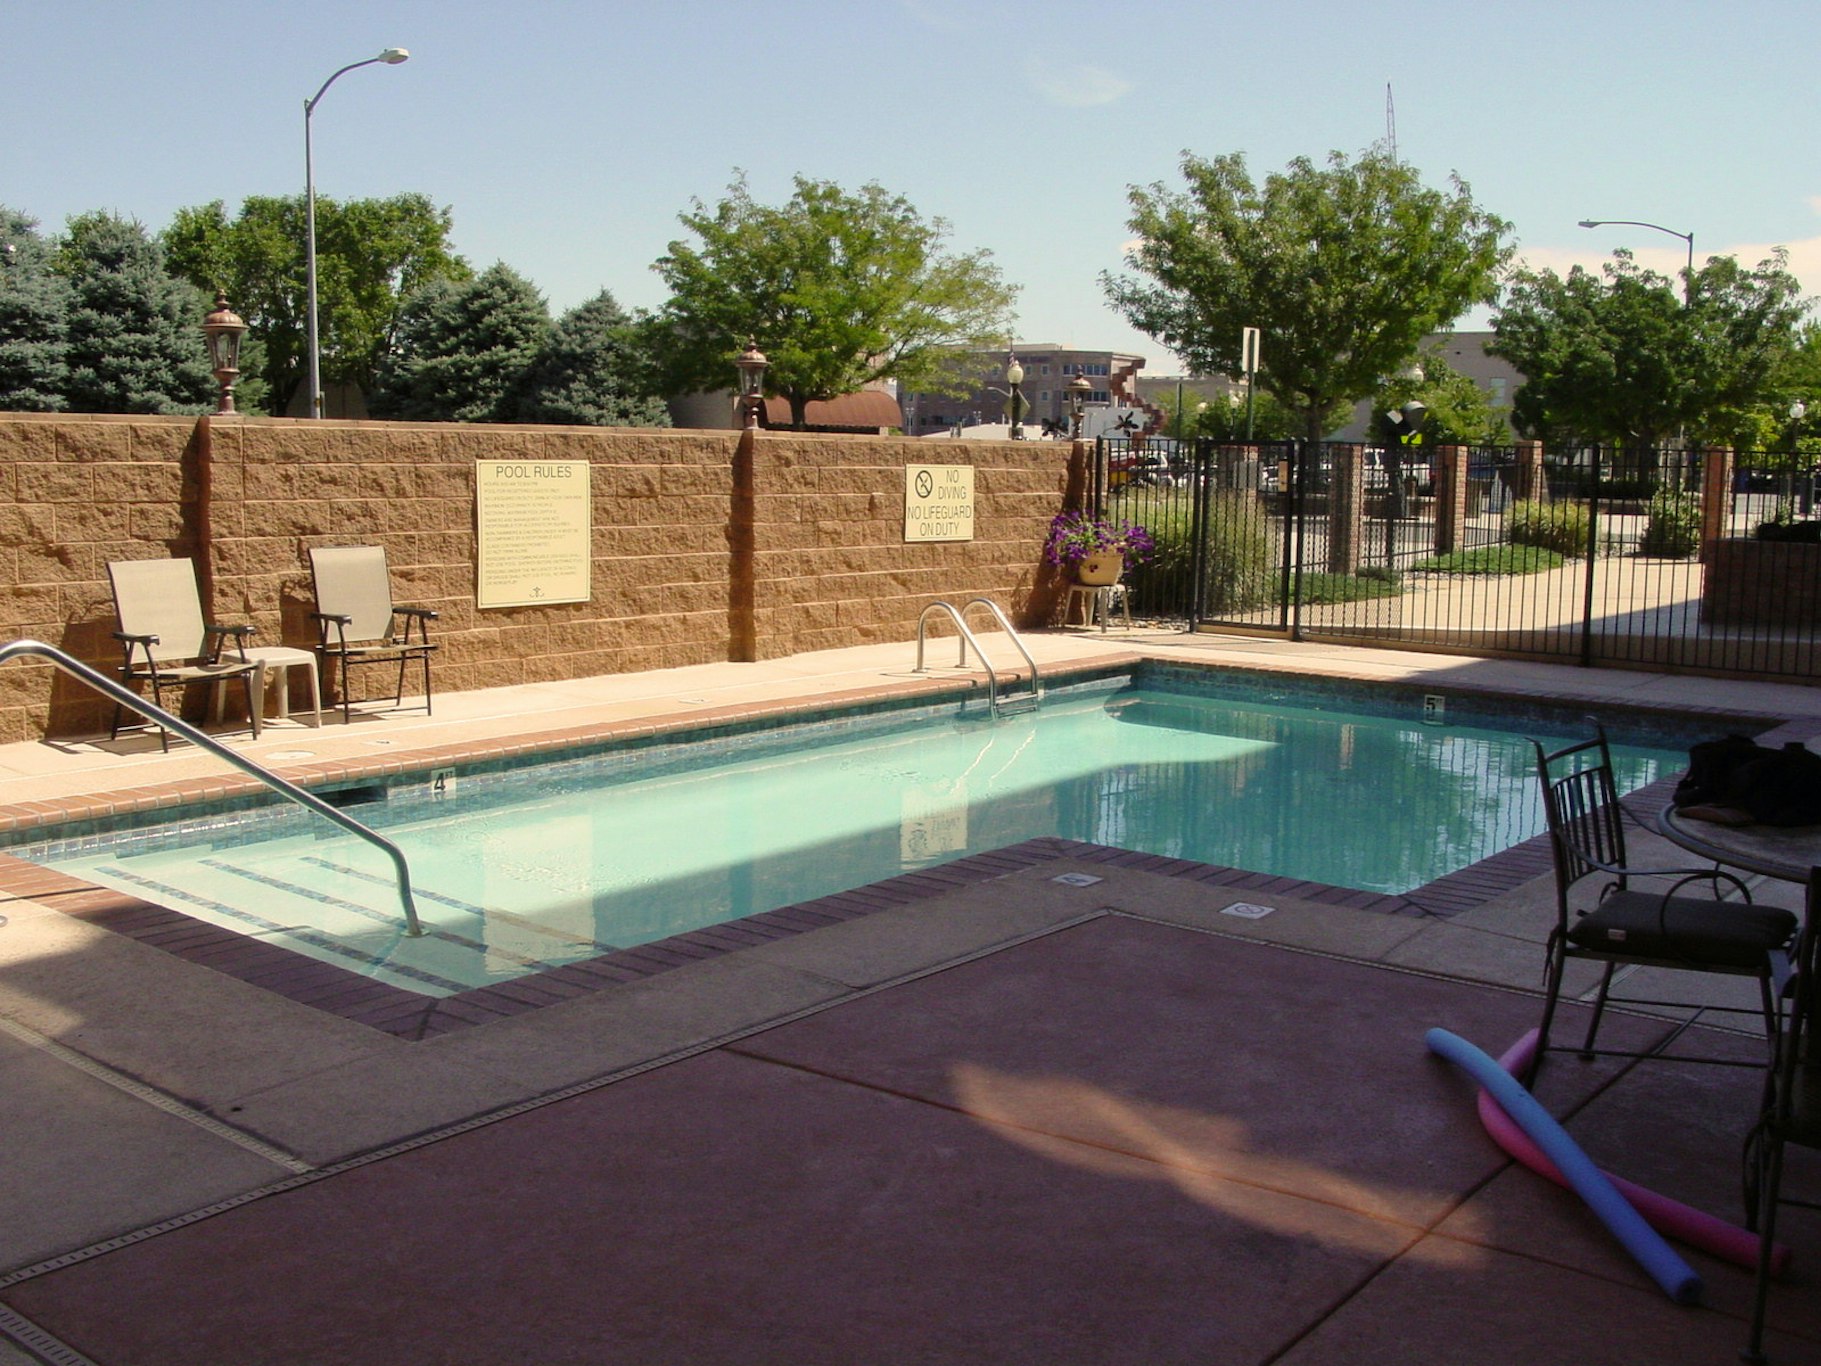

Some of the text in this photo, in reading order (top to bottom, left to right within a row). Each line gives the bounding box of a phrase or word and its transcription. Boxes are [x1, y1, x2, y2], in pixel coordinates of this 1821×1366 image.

[496, 466, 572, 478] POOL RULES
[946, 470, 959, 483] NO
[938, 486, 966, 499] DIVING
[908, 506, 972, 519] NO LIFEGUARD
[920, 522, 960, 536] ON DUTY
